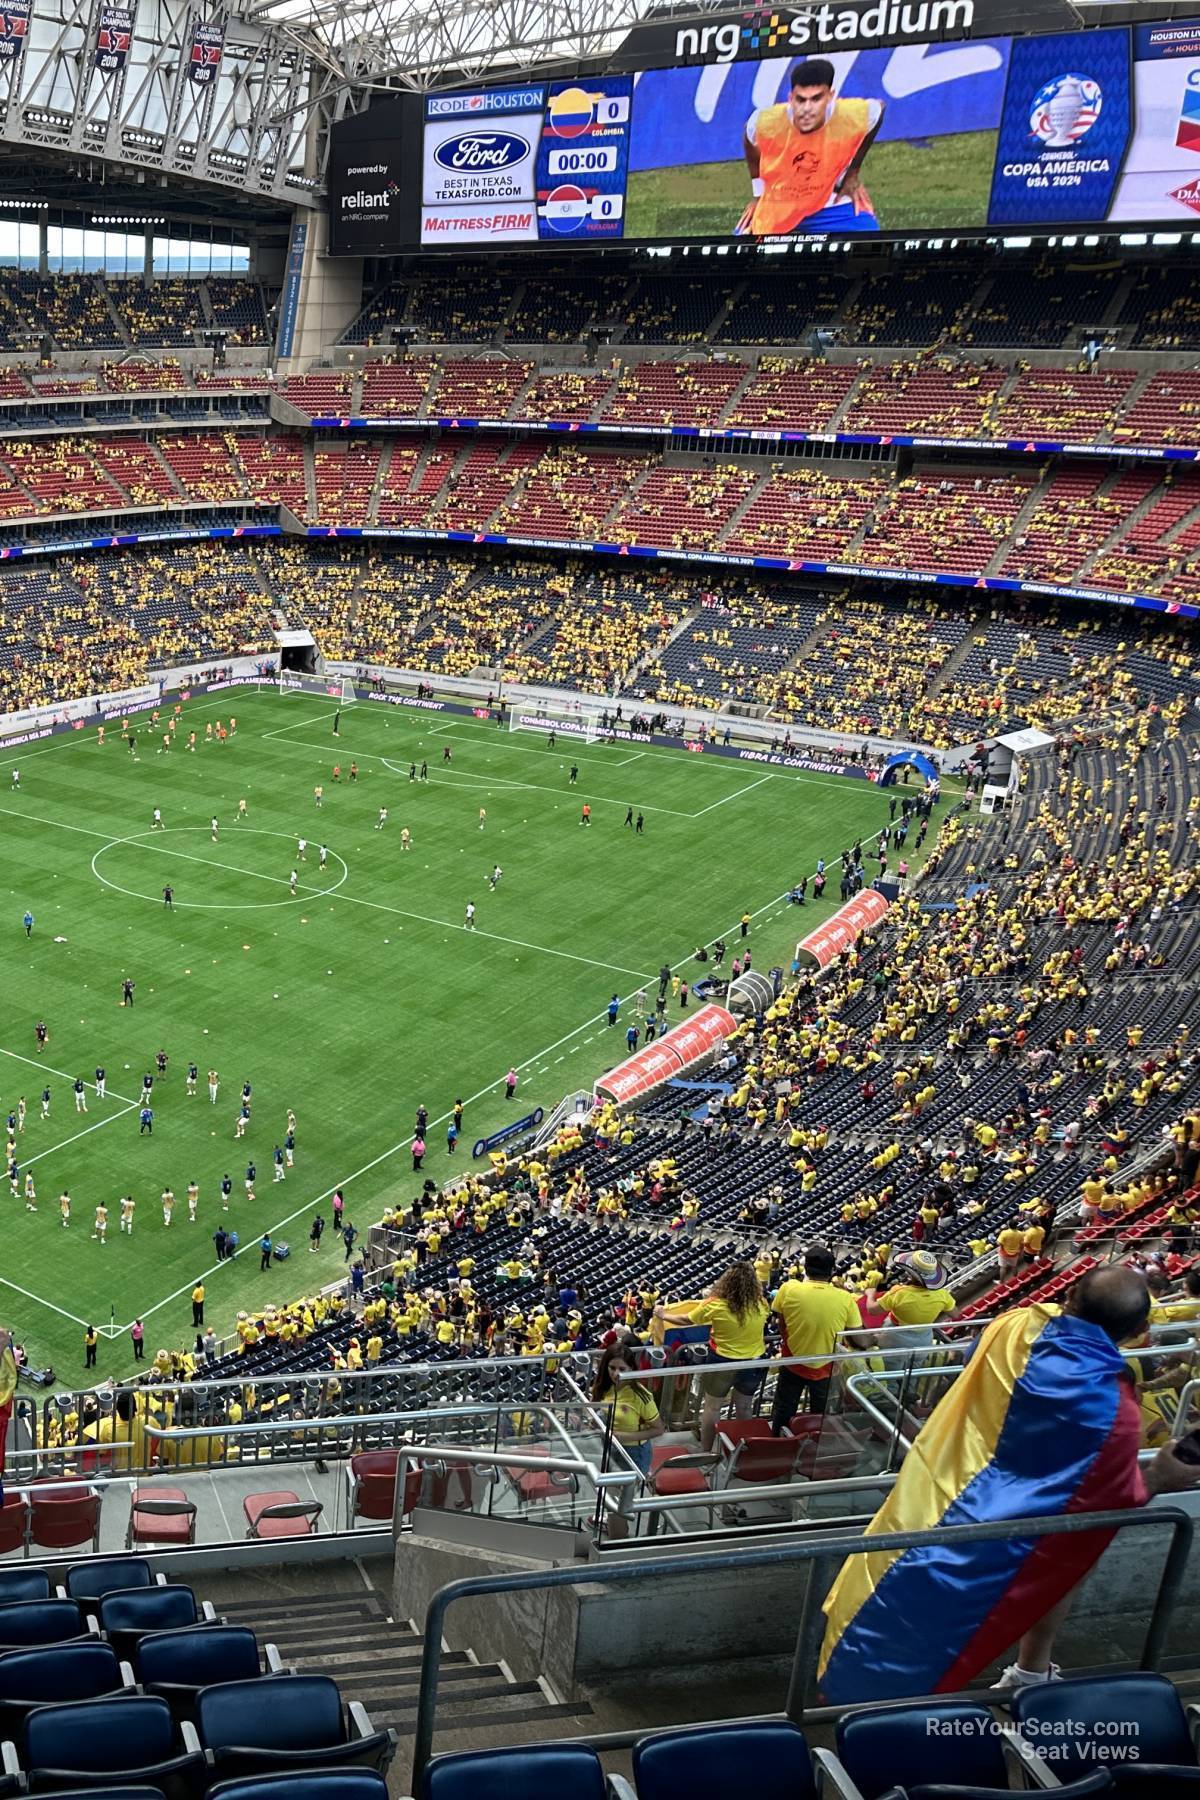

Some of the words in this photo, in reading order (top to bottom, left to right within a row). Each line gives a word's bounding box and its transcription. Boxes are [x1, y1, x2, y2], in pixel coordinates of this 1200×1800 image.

[102, 16, 131, 28] CHAMPIONS
[675, 21, 741, 63] nrg
[787, 0, 974, 45] stadium
[1150, 31, 1189, 41] HOUSTON
[608, 103, 619, 119] 0
[591, 128, 625, 137] COLOMBIA
[452, 137, 509, 167] Ford
[558, 152, 608, 171] 00:00
[1003, 161, 1041, 177] COPA
[1042, 159, 1110, 174] AMERICA
[347, 165, 377, 176] powered
[378, 164, 388, 174] by
[444, 179, 468, 189] BEST
[470, 178, 480, 187] IN
[482, 176, 513, 187] TEXAS
[1026, 177, 1049, 188] USA
[1052, 175, 1082, 187] 2024
[341, 190, 390, 209] reliant
[435, 187, 521, 199] TEXASFORD.COM
[601, 200, 613, 216] 0
[349, 213, 363, 221] NRG
[363, 213, 389, 223] company
[763, 235, 797, 244] MITSUBISHI
[798, 234, 828, 243] ELECTRIC
[368, 692, 387, 701] ROCK
[403, 697, 444, 710] CONTINENT
[520, 715, 560, 729] CONMEBOL
[560, 721, 580, 731] COPA
[580, 724, 615, 737] AMERICA
[616, 729, 630, 739] USA
[632, 732, 650, 743] 2024
[740, 750, 768, 761] VIBRA
[770, 755, 782, 763] EL
[784, 758, 846, 774] CONTINENTE
